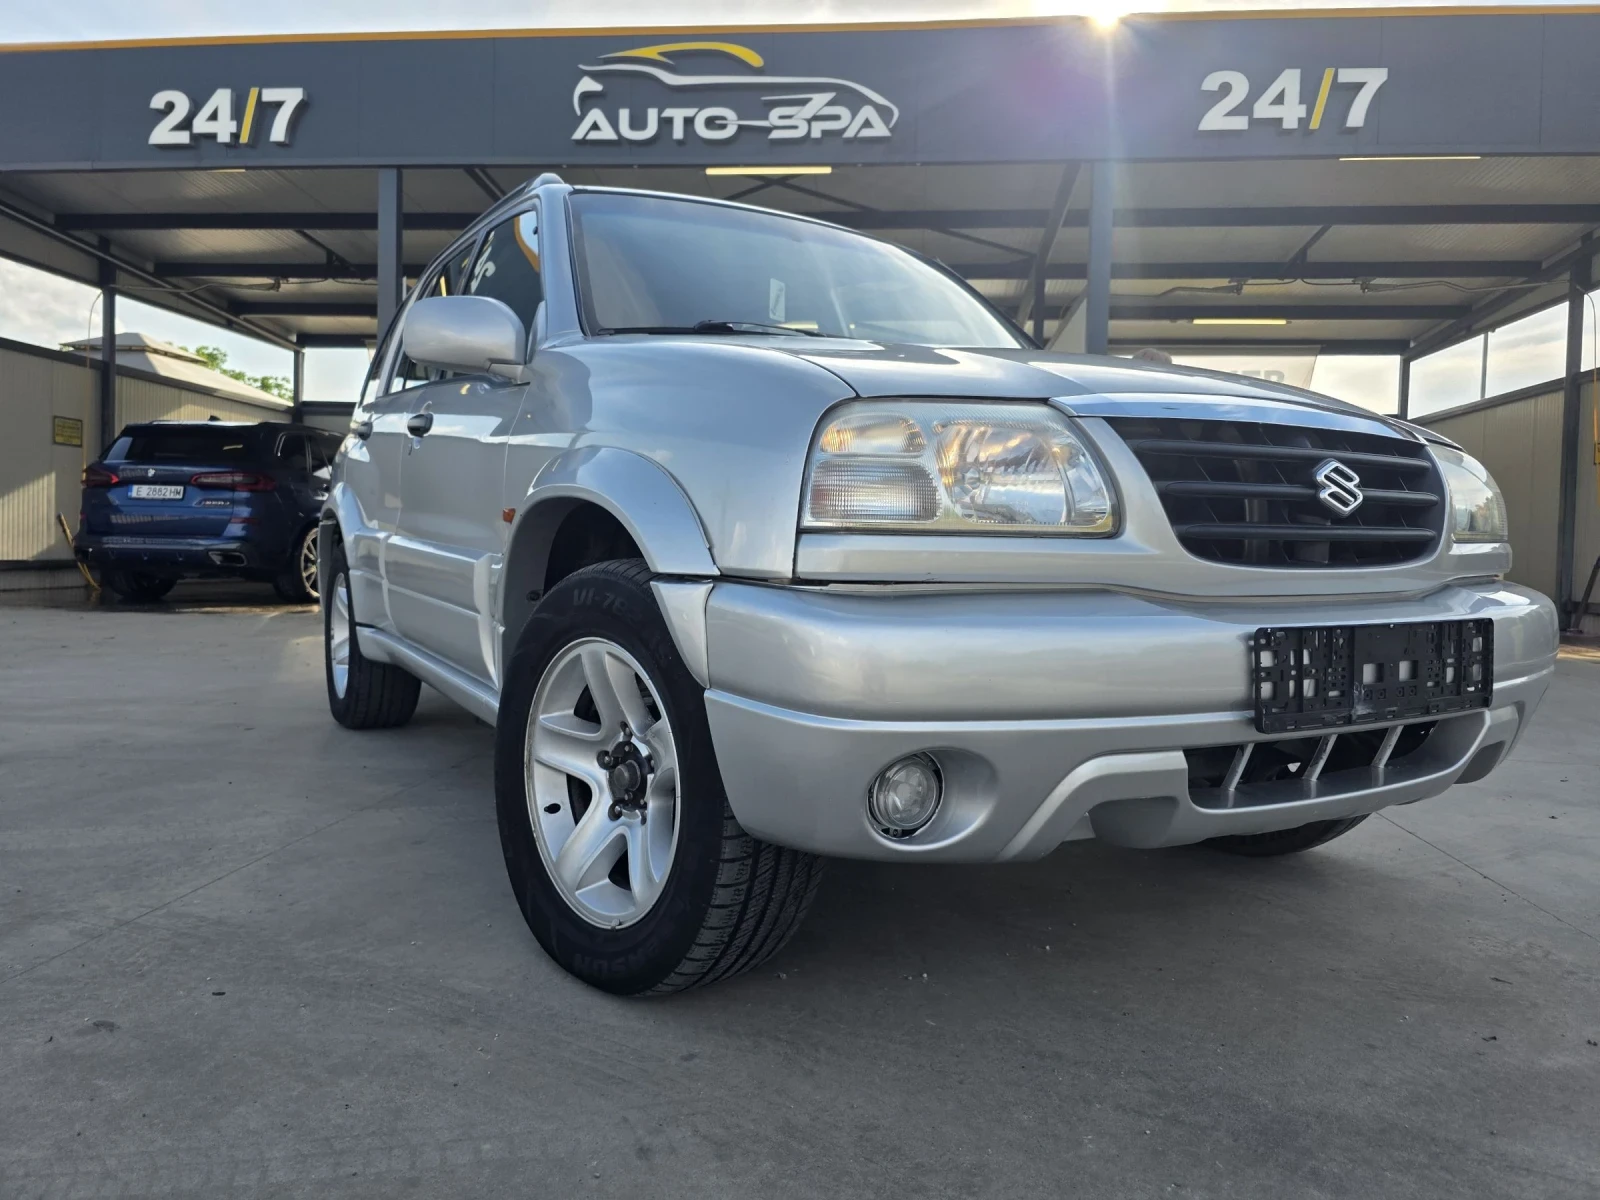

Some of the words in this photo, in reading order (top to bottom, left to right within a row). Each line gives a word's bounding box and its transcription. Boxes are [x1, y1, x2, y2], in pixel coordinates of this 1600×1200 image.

[148, 87, 304, 145] 24/7
[571, 106, 738, 141] AUTO
[1198, 67, 1389, 131] 24/7
